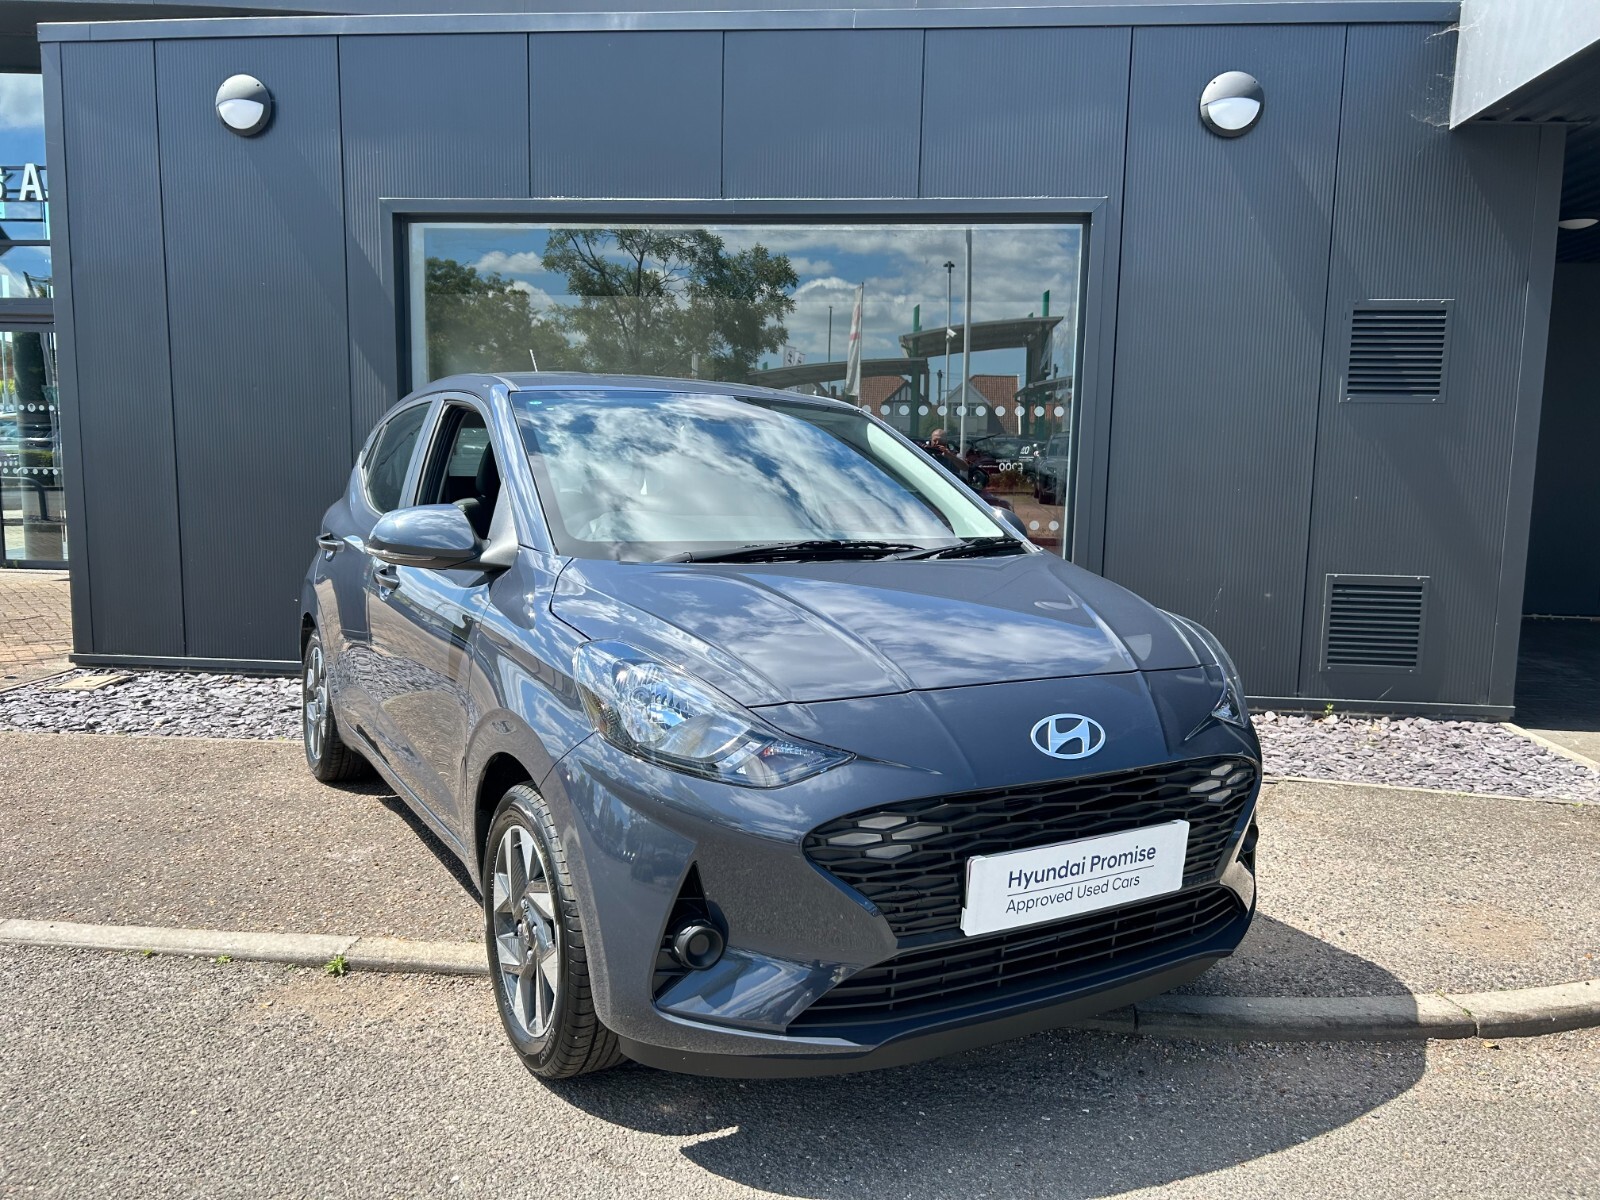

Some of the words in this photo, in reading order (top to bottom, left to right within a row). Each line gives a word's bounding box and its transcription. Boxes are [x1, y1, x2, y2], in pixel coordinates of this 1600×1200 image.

[1008, 856, 1086, 890] Hyundai
[1090, 845, 1156, 873] Promise
[1005, 886, 1074, 914] Approved
[1077, 879, 1109, 899] Used
[1112, 875, 1140, 891] Cars
